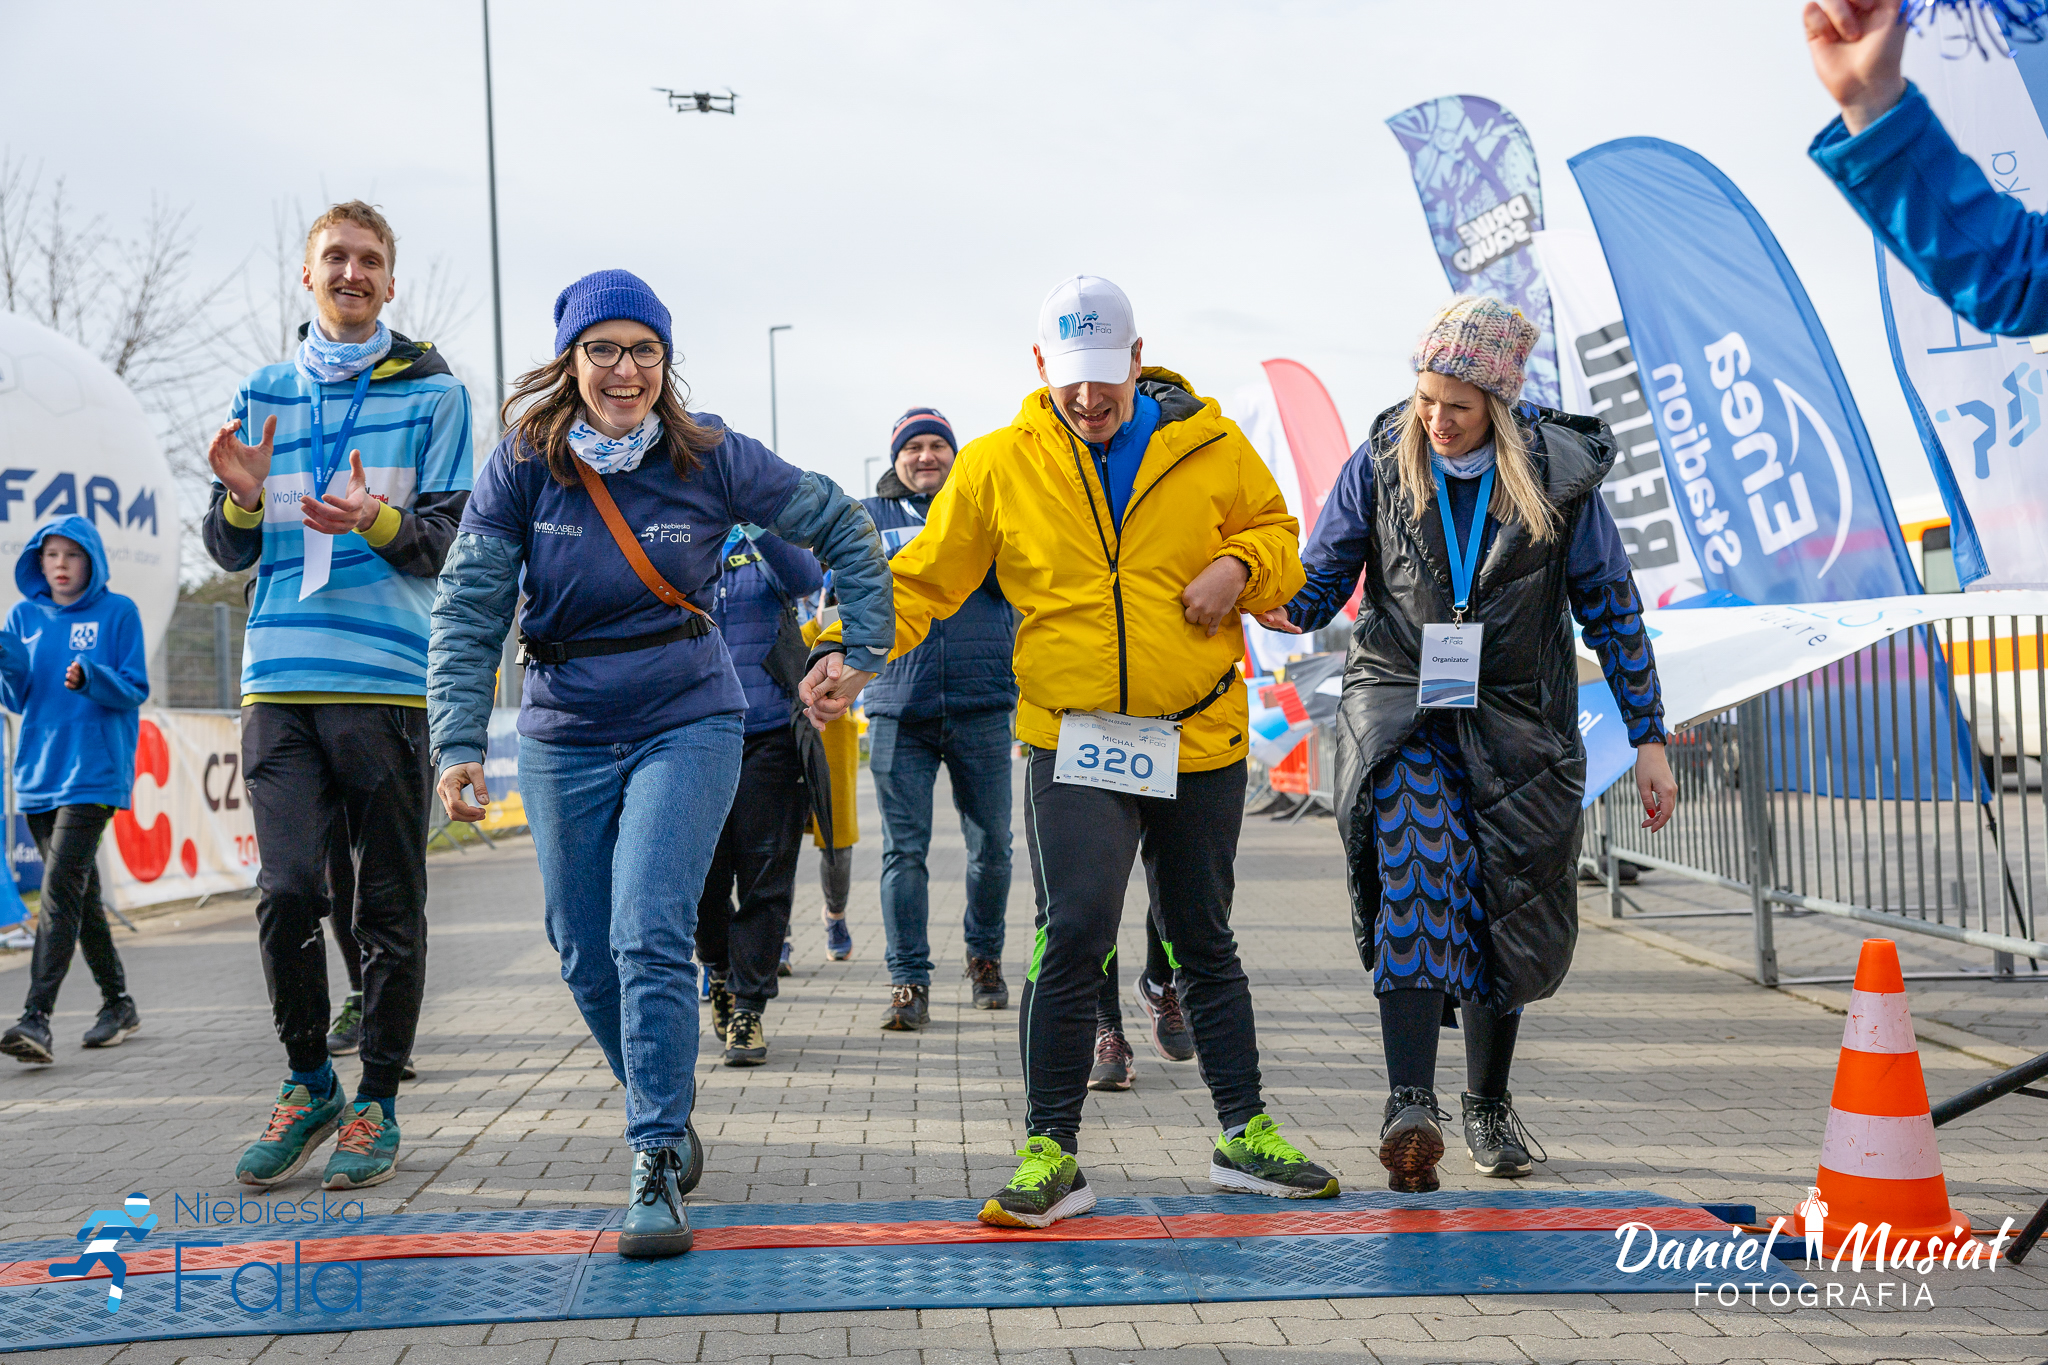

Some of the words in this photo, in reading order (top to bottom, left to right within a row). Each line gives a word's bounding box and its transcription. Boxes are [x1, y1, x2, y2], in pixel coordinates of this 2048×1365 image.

[1095, 326, 1112, 334] Fala
[272, 489, 311, 506] Wojtek
[660, 530, 691, 543] Fala
[1432, 656, 1469, 664] Organizator
[1102, 734, 1135, 748] MICHAŁ
[1149, 739, 1167, 748] Fala
[1076, 743, 1154, 779] 320
